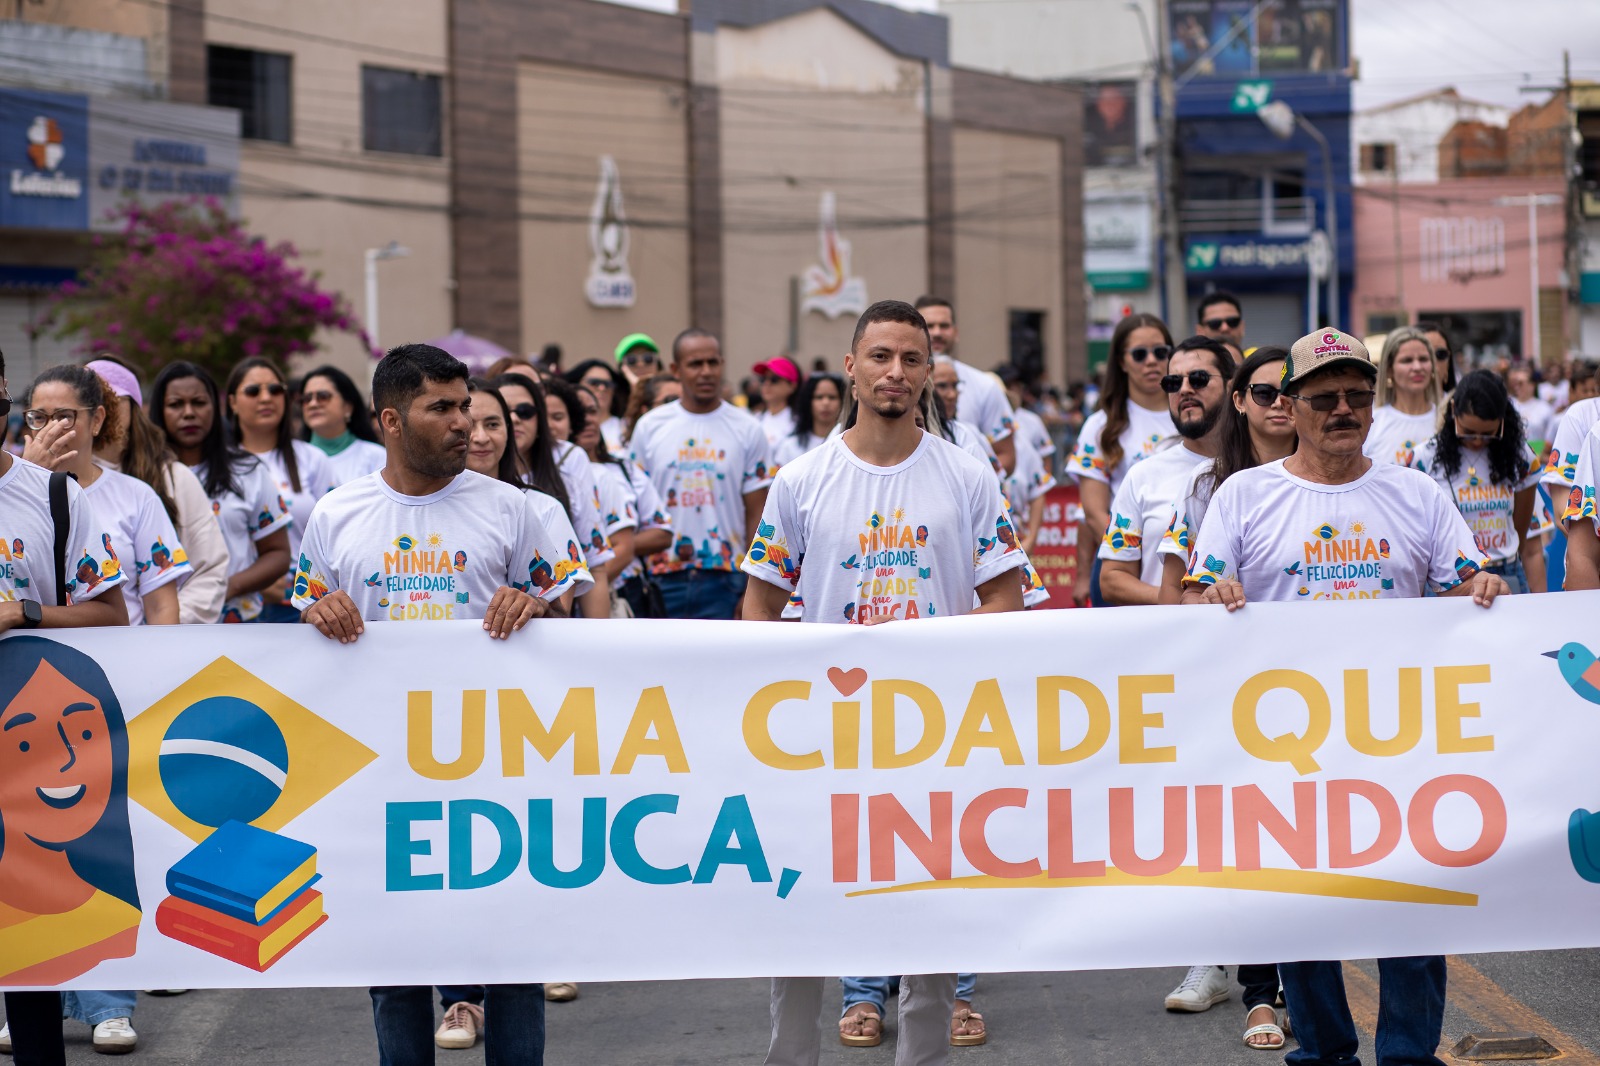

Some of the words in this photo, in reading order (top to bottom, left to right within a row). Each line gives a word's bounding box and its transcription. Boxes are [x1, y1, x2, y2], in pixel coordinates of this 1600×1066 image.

[1313, 344, 1352, 355] CENTRAL
[1459, 484, 1510, 501] MINHA
[859, 525, 916, 556] MINHA
[1304, 538, 1380, 564] MINHA
[384, 551, 453, 575] MINHA
[1334, 580, 1358, 590] uma
[410, 592, 431, 602] uma
[872, 596, 892, 605] que
[407, 686, 691, 781] UMA
[1232, 664, 1495, 776] QUE
[386, 793, 802, 899] EDUCA,
[831, 774, 1508, 884] INCLUINDO
